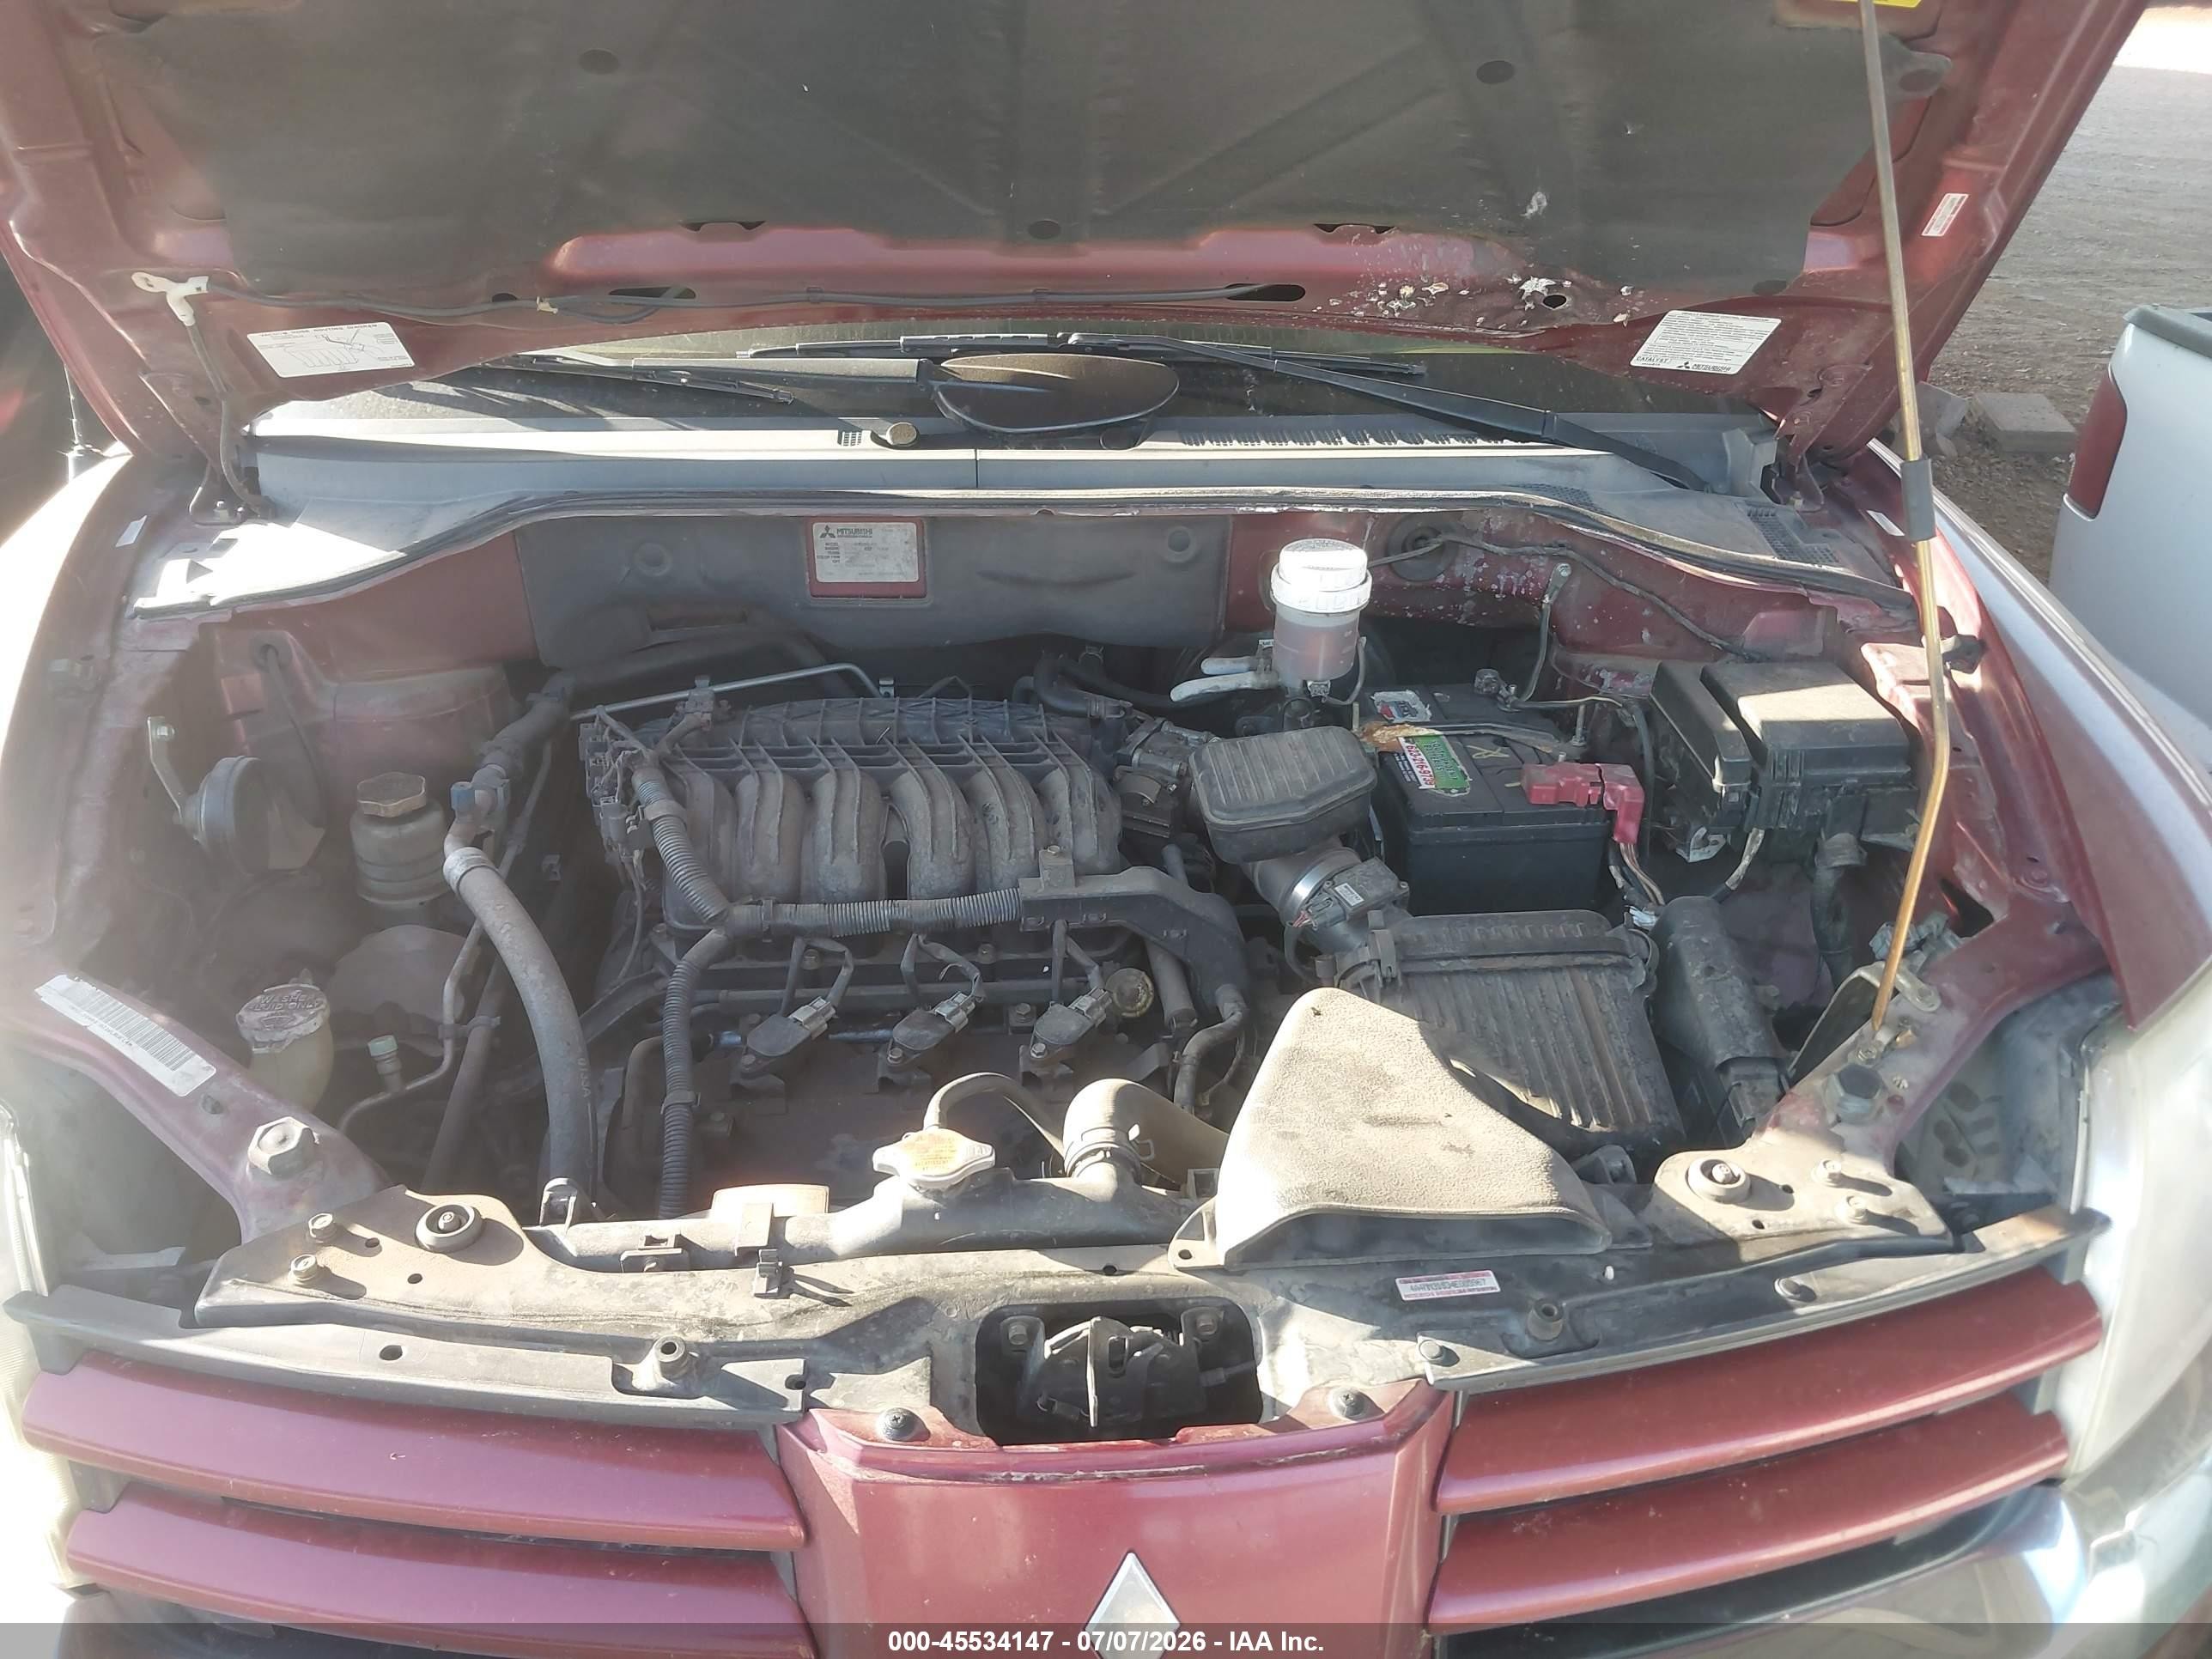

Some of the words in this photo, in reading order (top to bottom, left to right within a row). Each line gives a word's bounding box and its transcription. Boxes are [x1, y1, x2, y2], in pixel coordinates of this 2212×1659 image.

[1691, 364, 1733, 373] MITSUBISHI
[836, 527, 873, 536] MITSUBISHI
[1406, 744, 1436, 786] 623-216-9739
